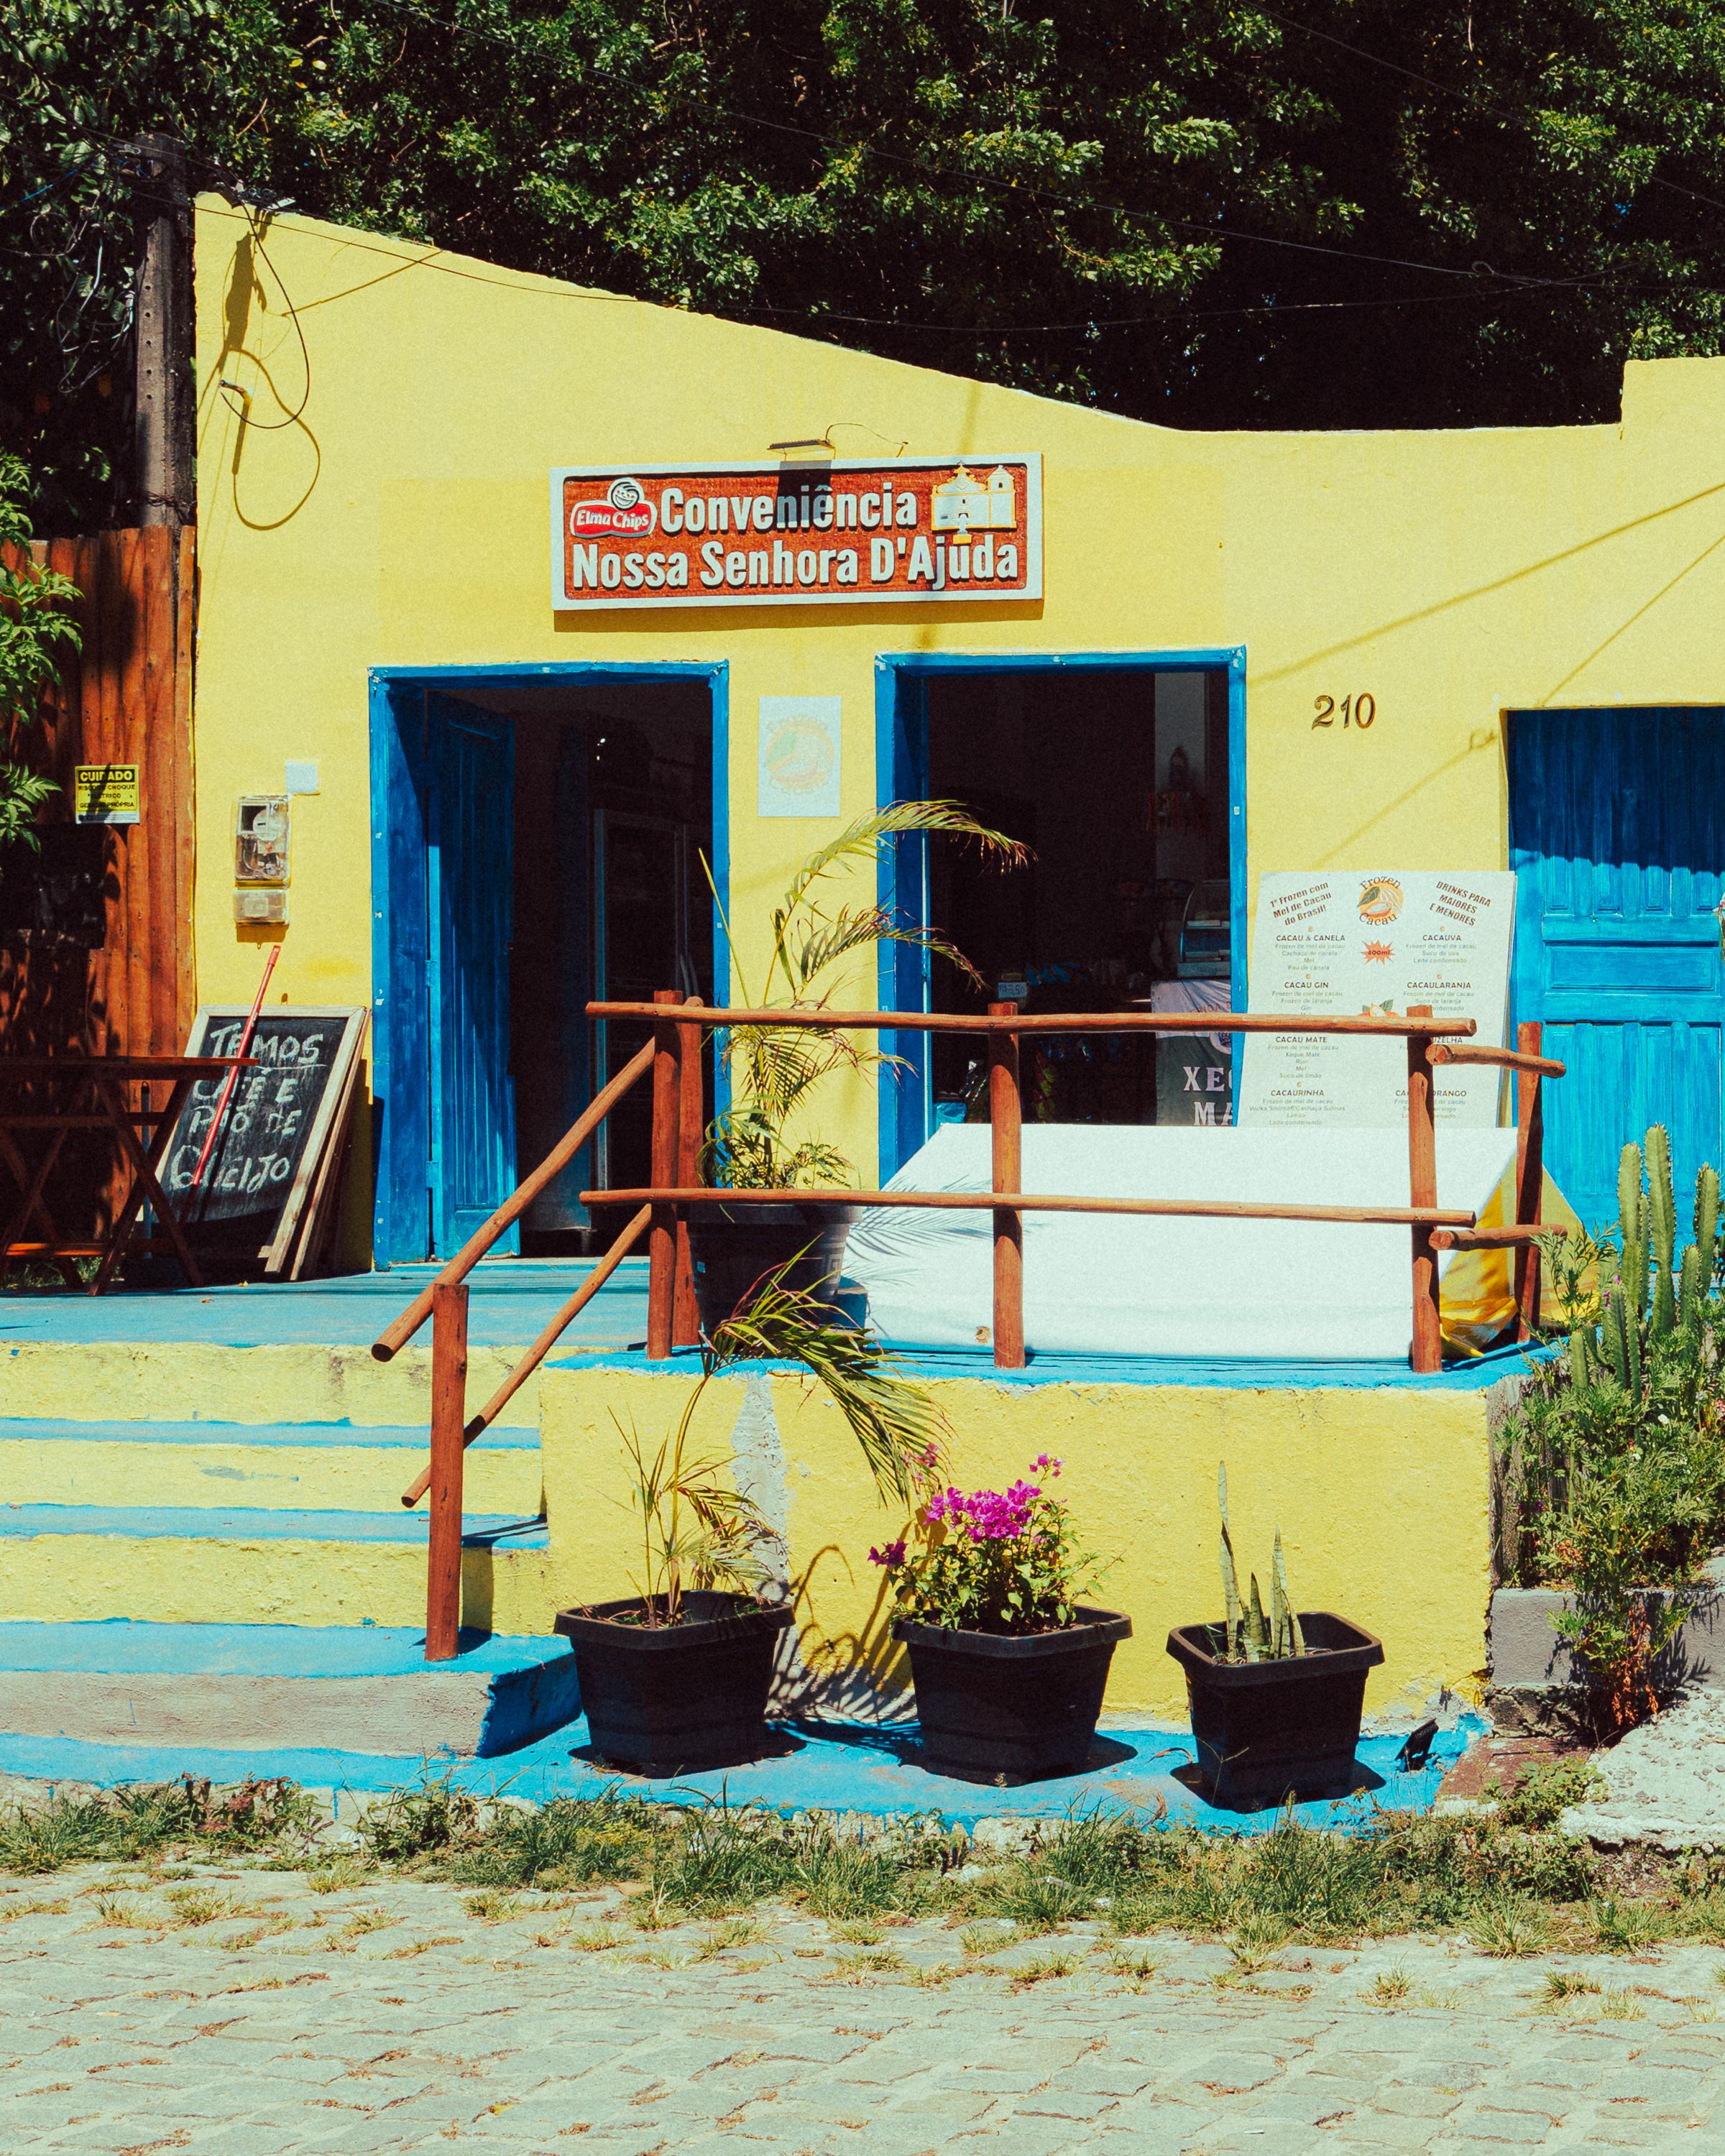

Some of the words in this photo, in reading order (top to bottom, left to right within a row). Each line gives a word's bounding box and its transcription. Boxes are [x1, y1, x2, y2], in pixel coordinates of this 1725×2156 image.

[660, 482, 917, 533] Conveniência
[576, 509, 611, 526] Elma
[612, 511, 649, 530] Chips
[574, 543, 689, 590] Nossa
[700, 538, 859, 588] Senhora
[870, 535, 1019, 591] D'Ajuda
[1312, 693, 1376, 730] 210
[1279, 890, 1307, 904] Frozen
[1310, 883, 1328, 894] com
[1360, 876, 1401, 890] Frozen
[1436, 881, 1468, 898] DRINKS
[1468, 893, 1491, 907] PARA
[1274, 906, 1289, 918] Mel
[1291, 903, 1302, 912] de
[1304, 892, 1332, 906] Cacau
[1439, 894, 1477, 913] MAIORES
[1284, 916, 1296, 926] do
[1297, 904, 1327, 921] Brasil!
[1359, 912, 1398, 926] Cacau
[1435, 905, 1476, 926] MENORES
[275, 1079, 300, 1103] E
